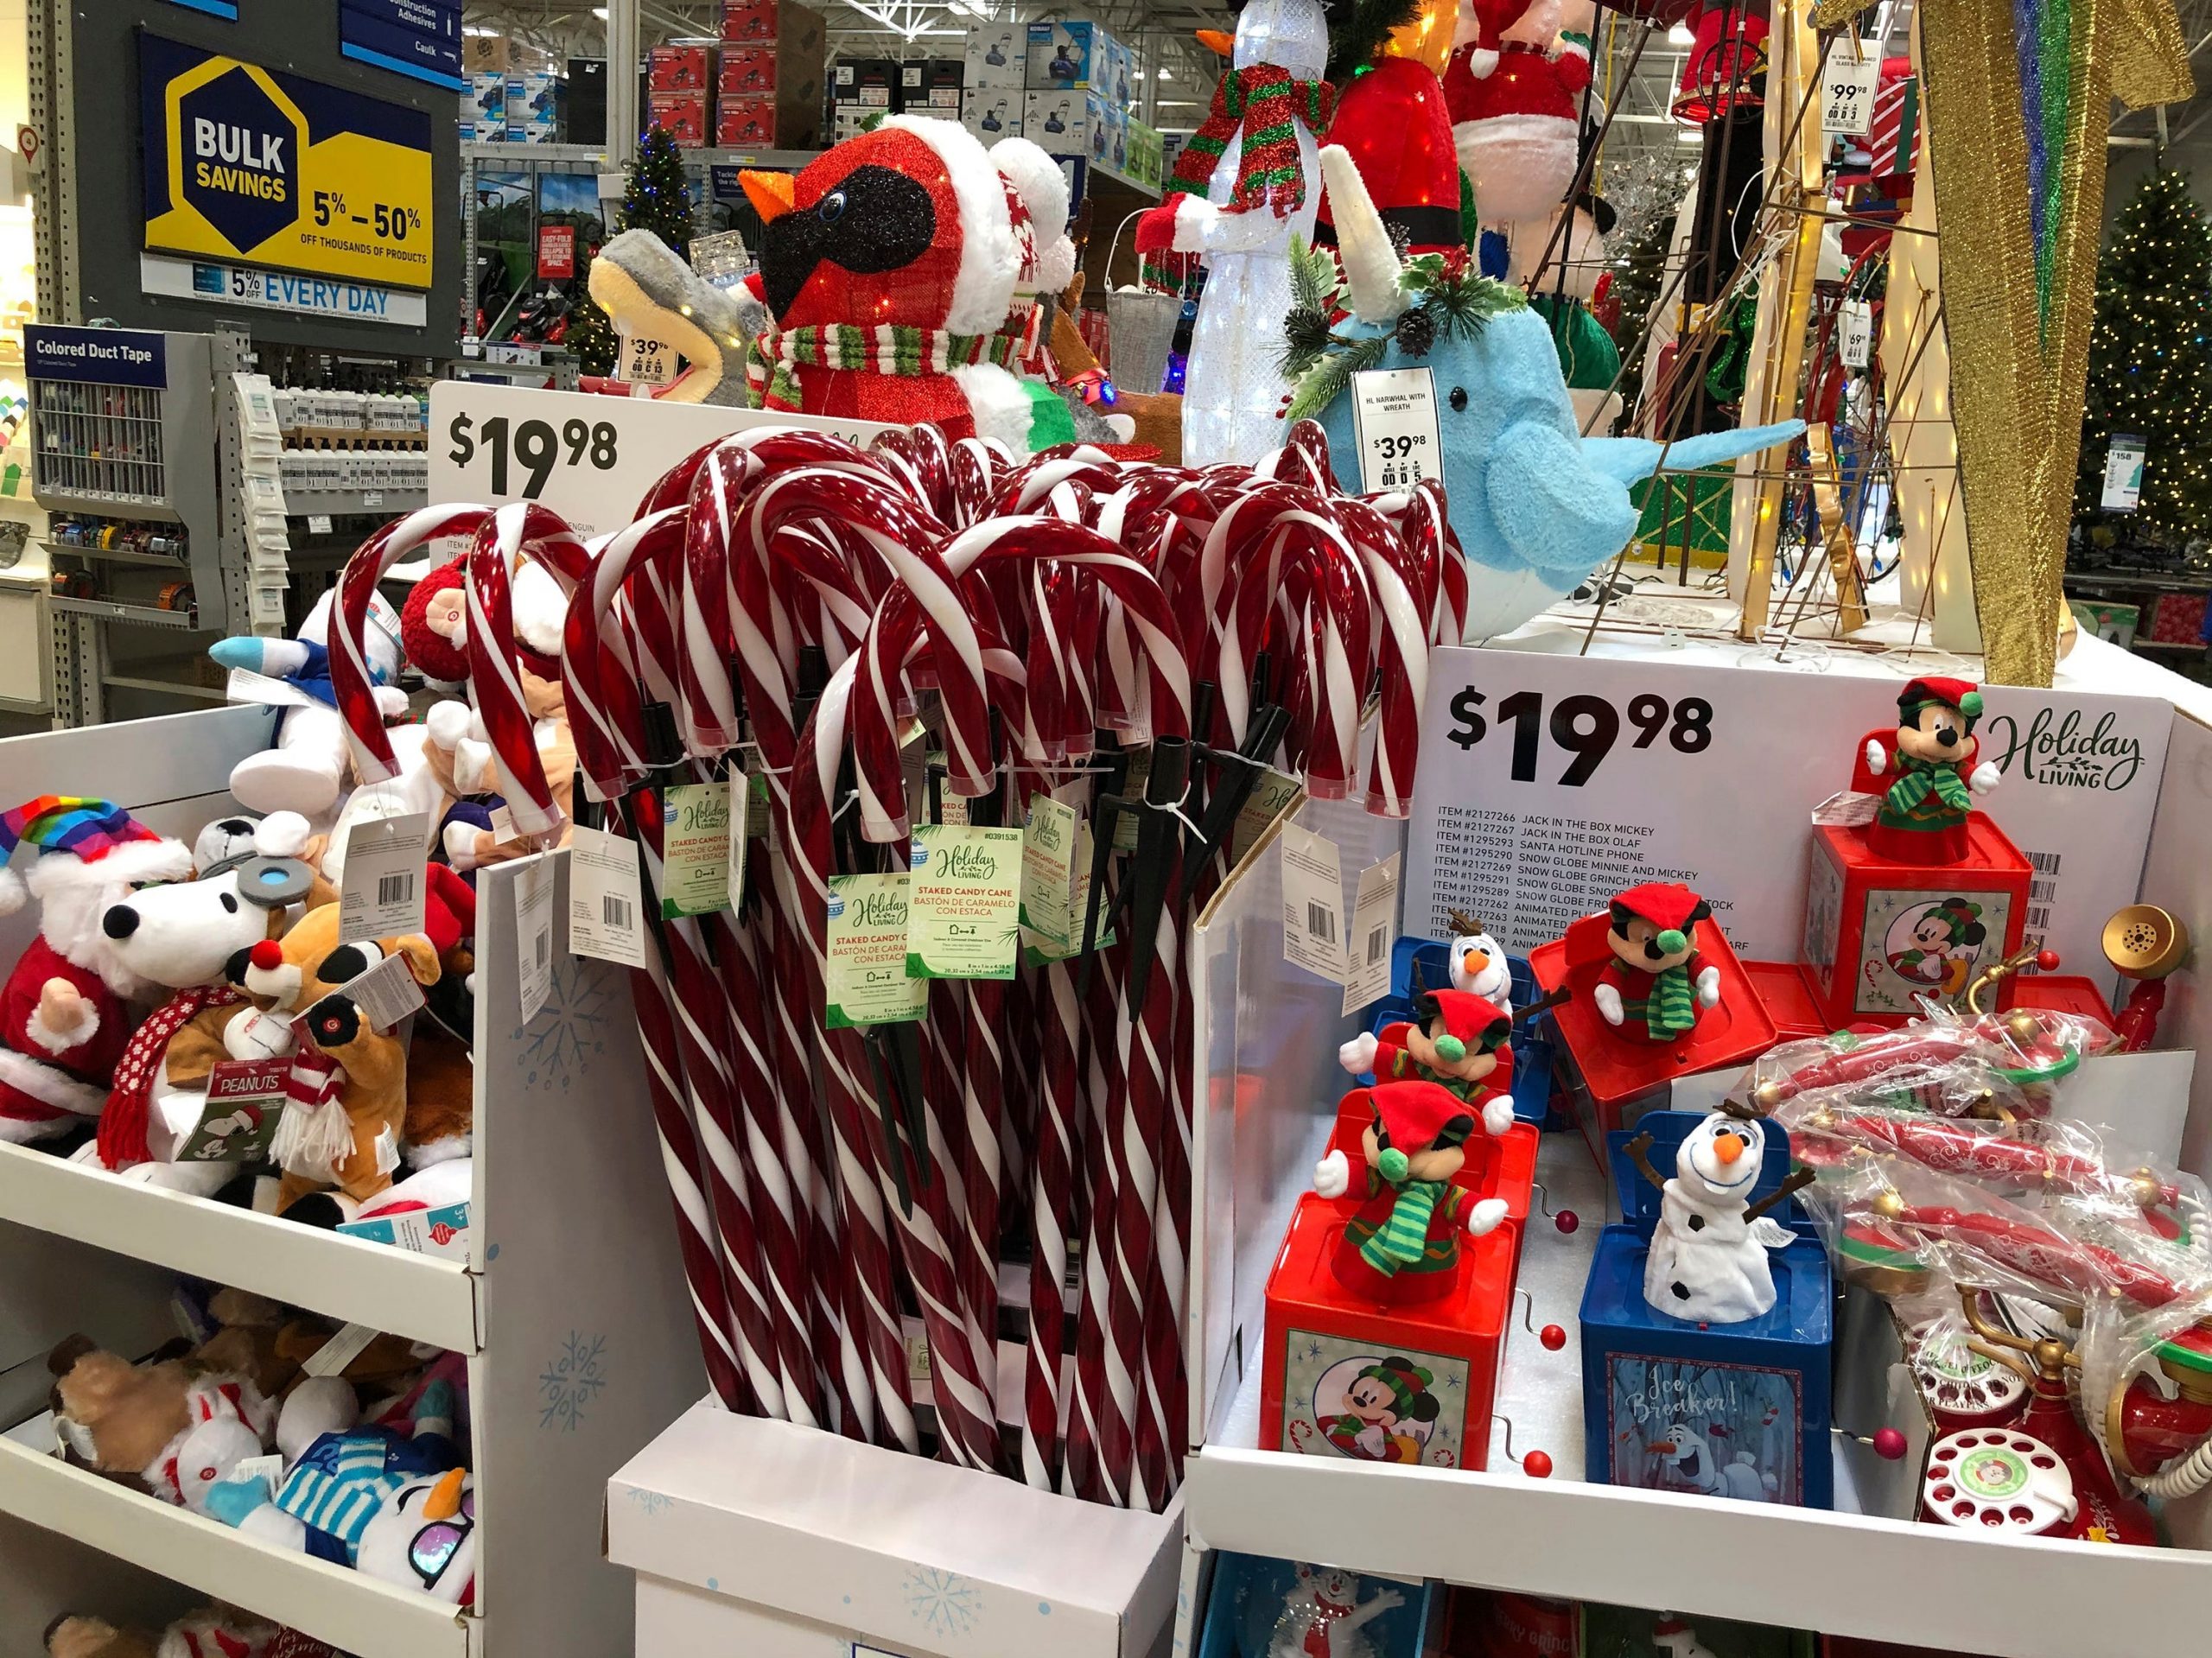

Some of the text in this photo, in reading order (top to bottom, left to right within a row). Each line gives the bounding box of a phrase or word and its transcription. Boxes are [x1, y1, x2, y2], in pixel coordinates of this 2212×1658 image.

[394, 0, 435, 17] onstruction
[397, 9, 436, 30] Adhesives
[415, 41, 436, 57] Caulk
[194, 117, 285, 173] BULK
[196, 162, 286, 202] SAVINGS
[374, 203, 421, 241] 50%
[301, 233, 428, 264] OFF THOUSANDS OF PRODUCTS
[265, 274, 346, 309] EVERY
[348, 286, 389, 315] DAY
[36, 340, 152, 365] Colored Duct Tape
[654, 365, 663, 374] 13
[1376, 395, 1408, 403] NARWHAL
[1383, 403, 1411, 412] WREATH
[1401, 473, 1408, 485] D
[568, 521, 595, 532] ENGUIN
[447, 540, 464, 549] ITEM
[1988, 707, 2145, 791] Holiday
[2038, 769, 2101, 789] LIVING
[1438, 806, 1655, 836] ITEM #2127266 JACK IN THE BOX MICKEY
[671, 835, 722, 848] STAKED CANDY
[984, 832, 1018, 842] #0391538
[1437, 818, 1642, 848] ITEM #2127267 JACK IN THE BOX OLAF
[1436, 831, 1644, 861] ITEM #1295293 SANTA HOTLINE PHONE
[685, 852, 728, 864] CON ESTACA
[936, 844, 997, 880] Holiday
[1435, 843, 1699, 880] ITEM #1295290 SNOW GLOBE MINNIE AND MICKEY
[957, 871, 982, 880] LIVING
[1433, 868, 1459, 879] ITEM
[1460, 872, 1510, 885] #1295291
[1516, 878, 1548, 889] SNOW
[1551, 881, 1586, 894] GLOBE
[1434, 856, 1459, 867] ITEM
[1461, 860, 1512, 873] #2127269
[1517, 866, 1550, 877] SNOW
[1552, 869, 1587, 881] GLOBE
[1590, 873, 1630, 886] GRINCH
[913, 896, 1016, 908] BASTÓN DE CARAMELO
[918, 886, 952, 895] STAKED
[988, 889, 1013, 898] CANE
[1433, 880, 1458, 891] ITEM
[1459, 884, 1510, 897] #1295289
[1516, 890, 1548, 902] SNOW
[1549, 894, 1585, 906] GLOBE
[853, 892, 908, 927] Holiday
[936, 907, 993, 917] CON ESTACA
[1433, 893, 1568, 916] ITEM #2127262 ANIMATED
[873, 918, 896, 927] LIVING
[1513, 915, 1567, 929] ANIMATED
[836, 935, 899, 946] STAKED CANDY
[1430, 929, 1545, 950] ITEM ANIM
[832, 946, 868, 956] BASTÓN
[854, 953, 906, 964] CON ESTACA
[220, 1075, 280, 1093] PEANUTS
[1649, 1365, 1684, 1401] Ice
[1625, 1381, 1738, 1424] Breaker!
